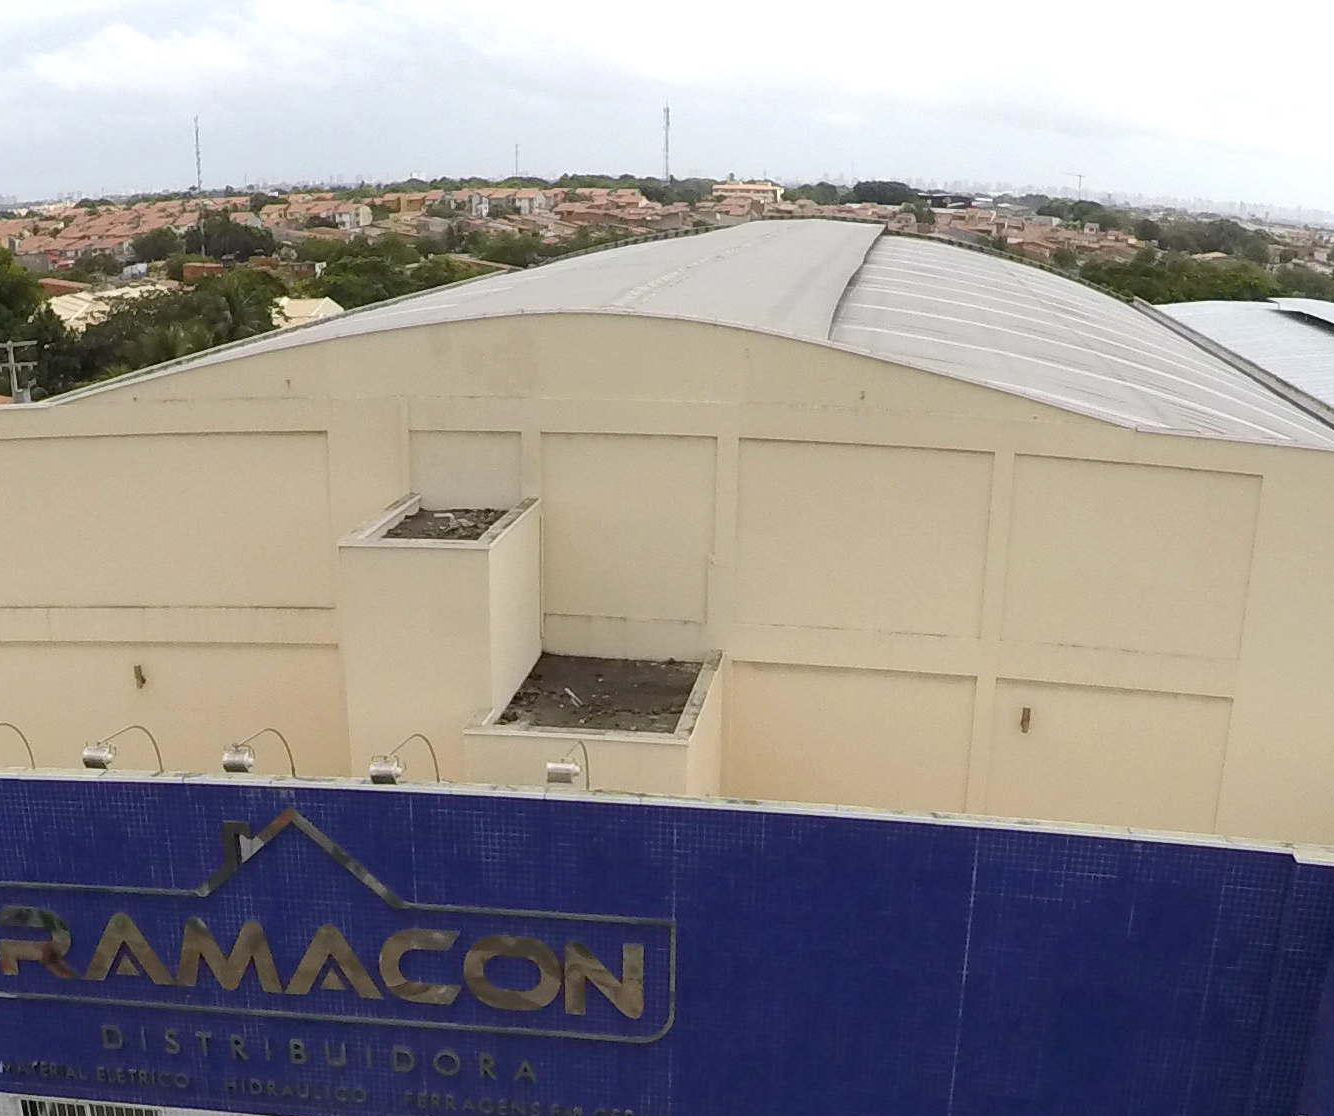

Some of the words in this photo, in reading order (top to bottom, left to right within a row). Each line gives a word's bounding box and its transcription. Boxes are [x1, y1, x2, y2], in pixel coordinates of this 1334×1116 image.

[101, 1024, 538, 1083] DISTRIBUIDORA
[0, 1060, 88, 1081] MATERIAL
[405, 1090, 541, 1116] FERRAGENS
